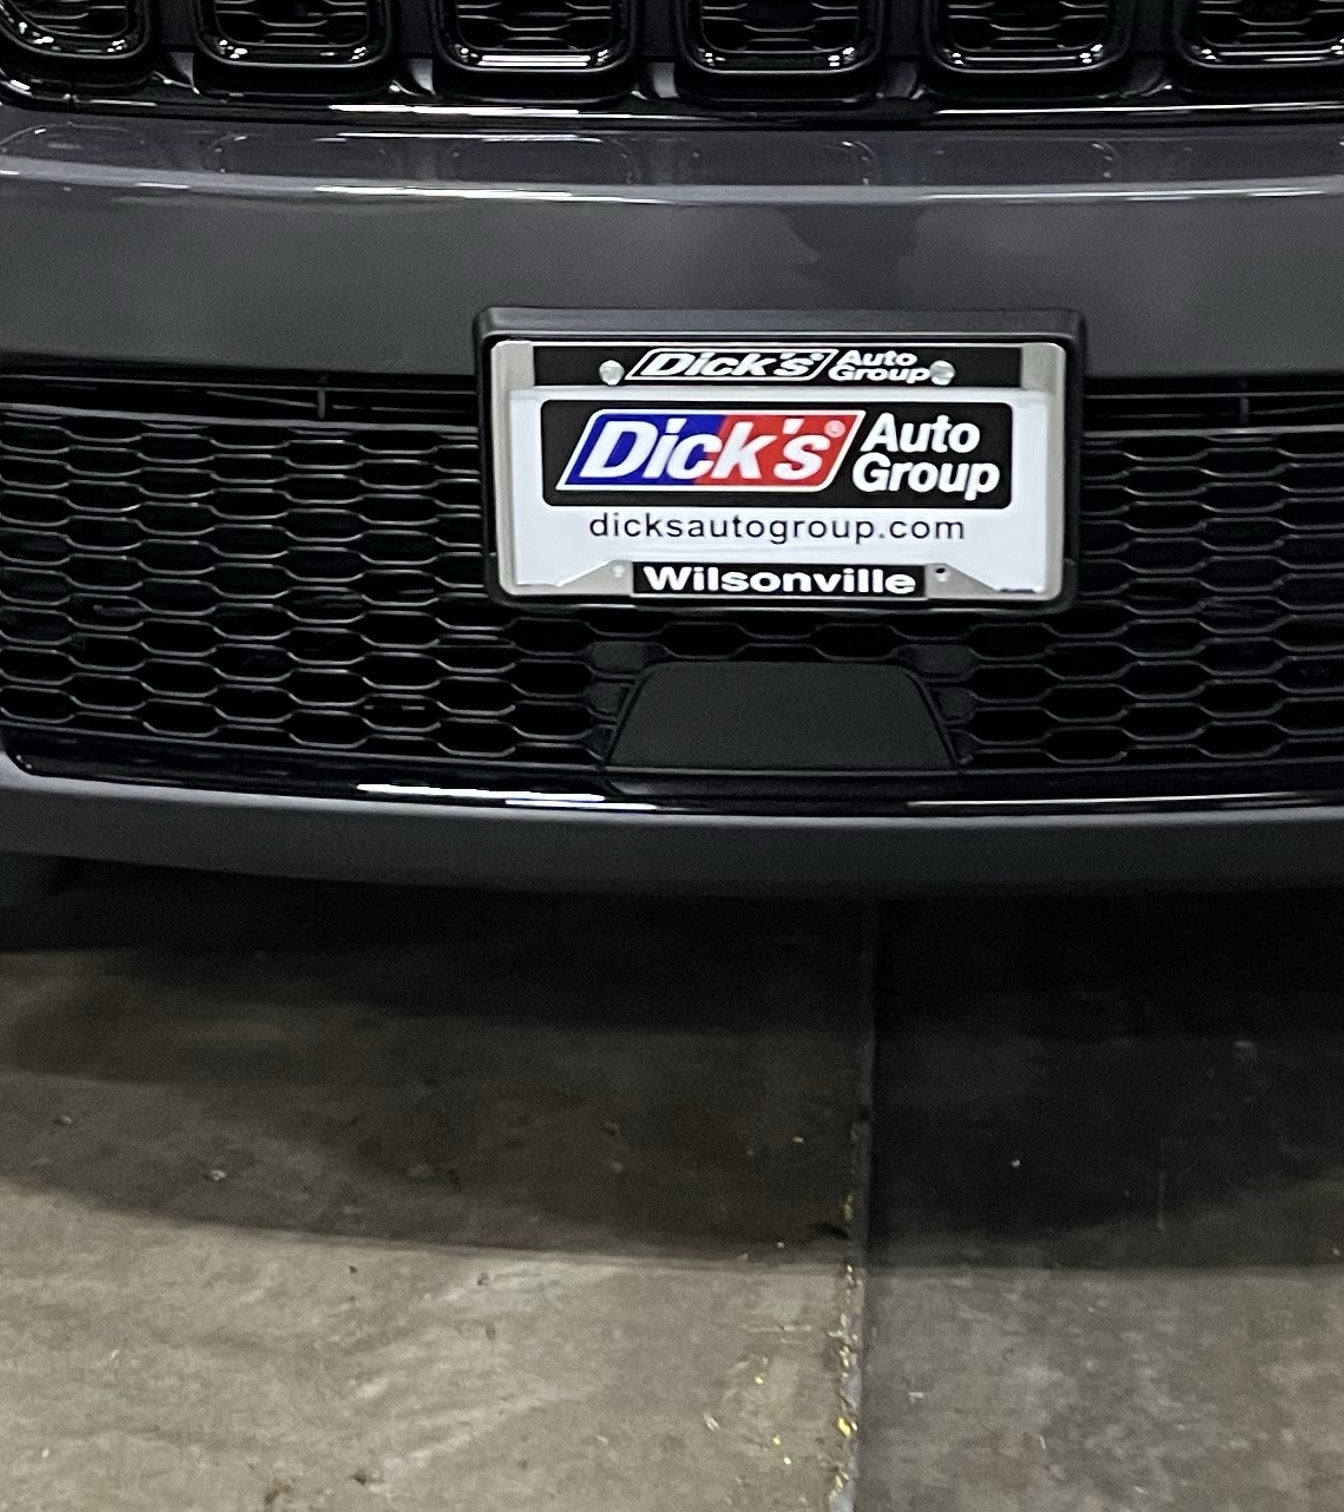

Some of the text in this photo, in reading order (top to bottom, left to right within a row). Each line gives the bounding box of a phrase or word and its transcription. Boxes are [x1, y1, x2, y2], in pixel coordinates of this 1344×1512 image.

[639, 349, 918, 377] Dick's Auto
[828, 363, 931, 384] Group
[579, 413, 981, 481] Dick's Auto
[852, 451, 1000, 500] Group
[589, 512, 965, 544] dicksautogroup.com
[642, 565, 917, 594] Wilsonville
